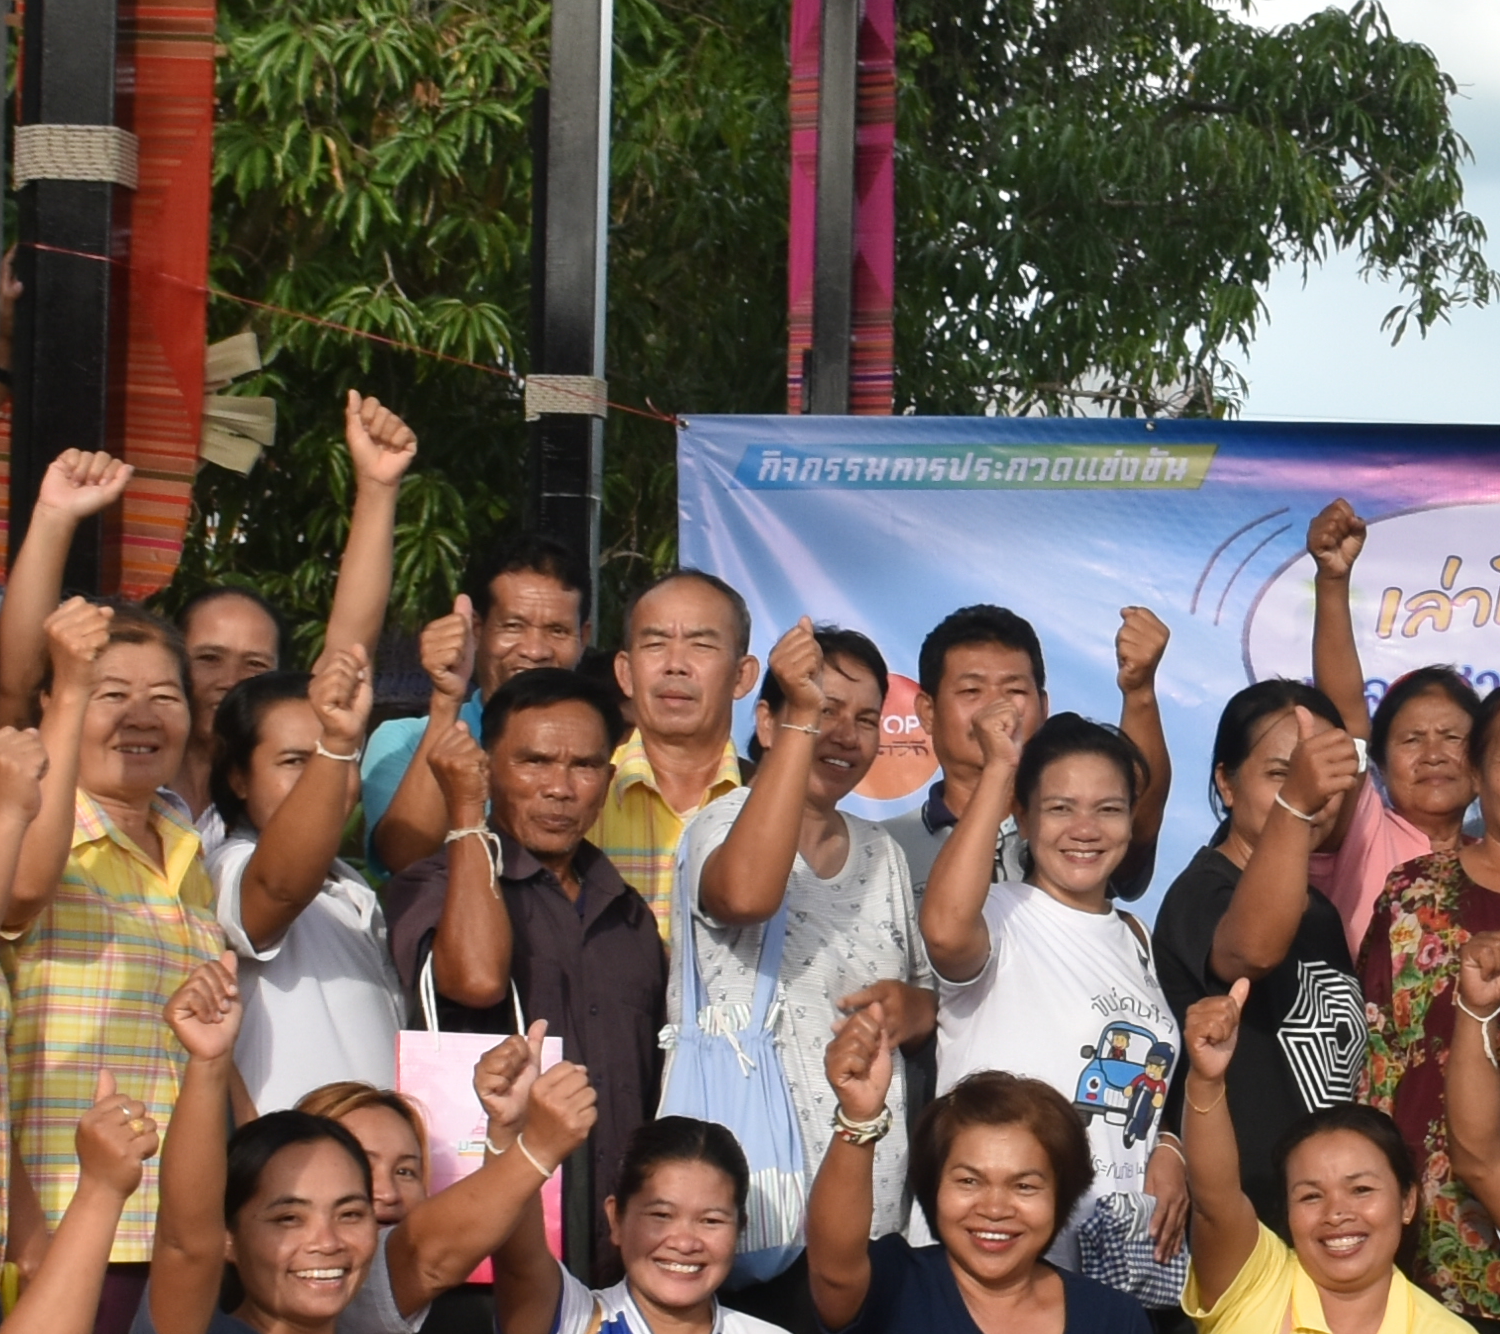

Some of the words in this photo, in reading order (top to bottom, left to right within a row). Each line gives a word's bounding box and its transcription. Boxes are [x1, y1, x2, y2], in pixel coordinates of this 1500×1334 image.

[757, 447, 1190, 482] กิจกรรมการประกวดแข่งขัน
